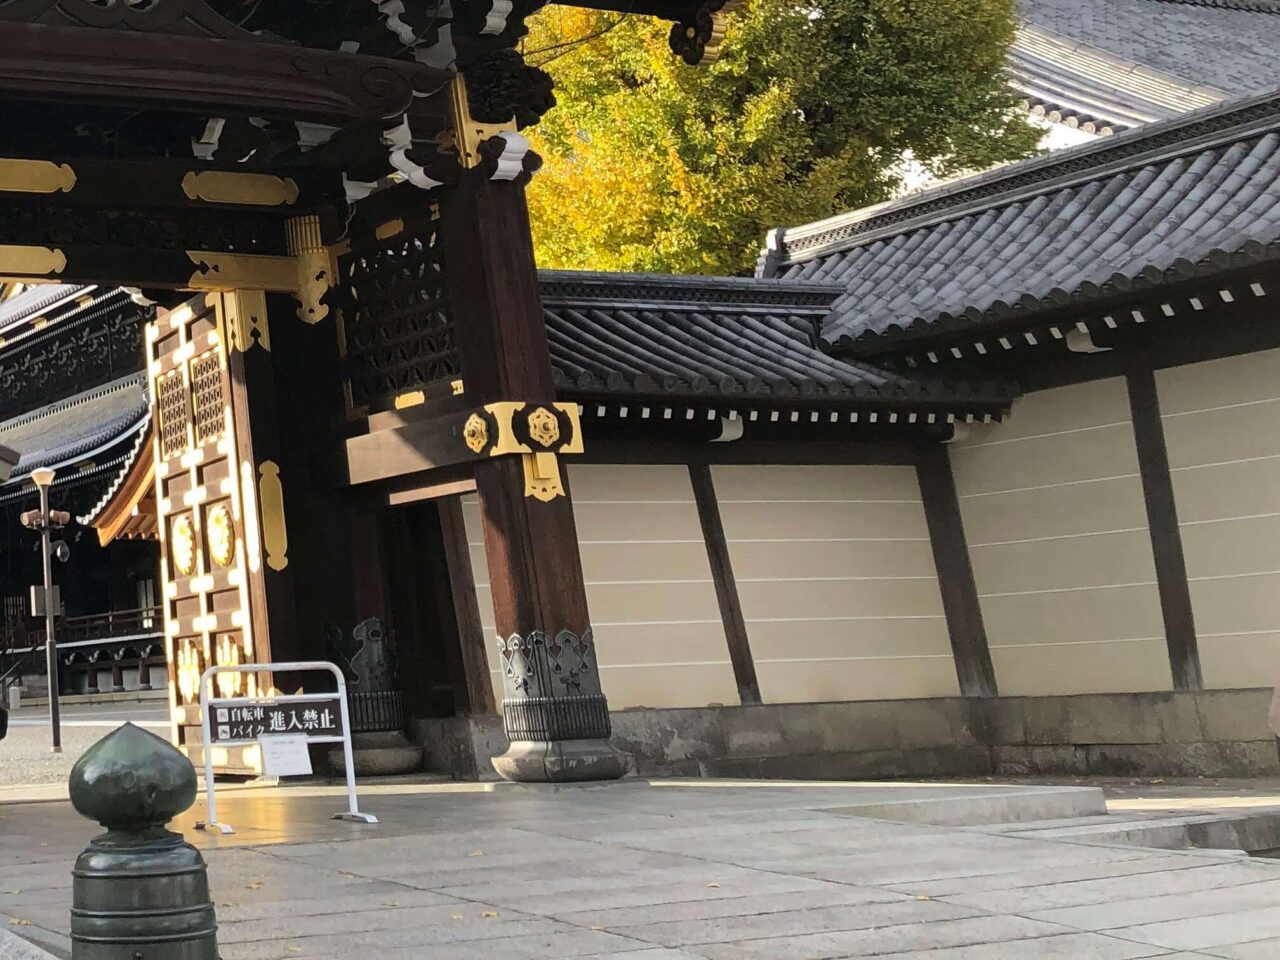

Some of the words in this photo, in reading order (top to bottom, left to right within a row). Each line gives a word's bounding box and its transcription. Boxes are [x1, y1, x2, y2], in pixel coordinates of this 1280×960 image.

[231, 707, 265, 722] 自転車
[269, 708, 336, 730] 進入禁止
[232, 724, 265, 738] バイク
